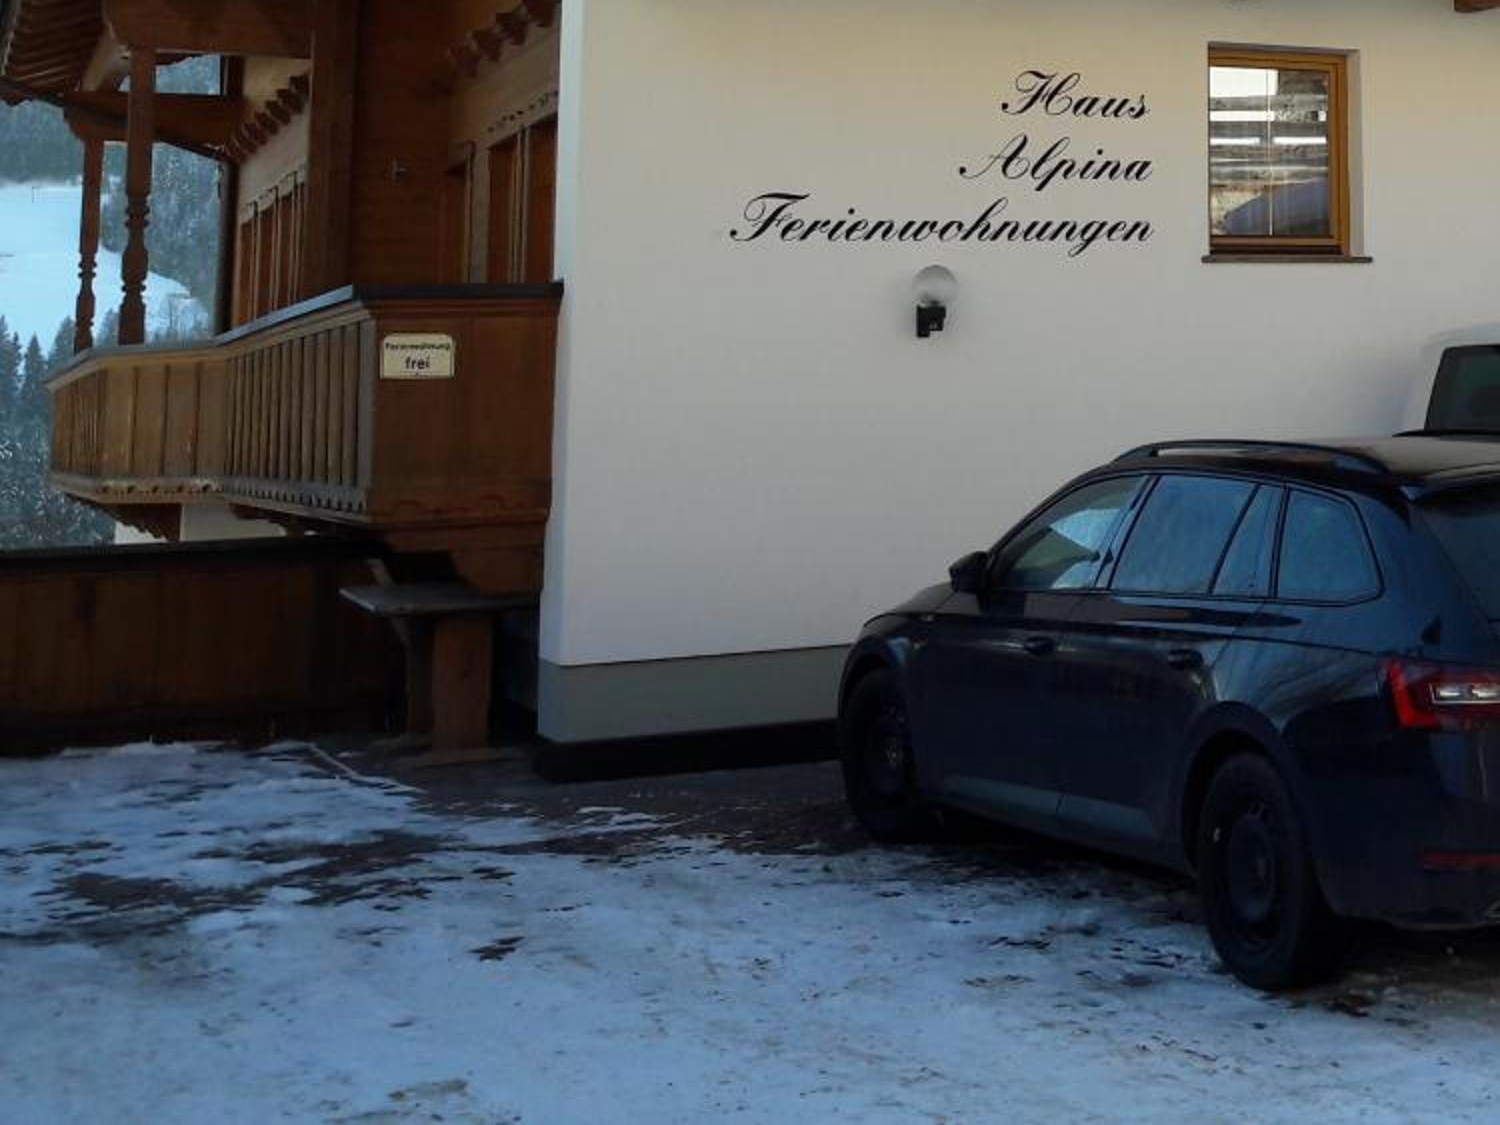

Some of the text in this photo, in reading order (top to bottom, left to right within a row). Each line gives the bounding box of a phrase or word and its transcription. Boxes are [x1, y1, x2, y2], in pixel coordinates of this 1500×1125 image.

[1001, 70, 1151, 119] Haus
[959, 133, 1153, 192] Alpina
[729, 192, 1154, 257] Ferienwohnungen
[405, 355, 431, 370] frei
